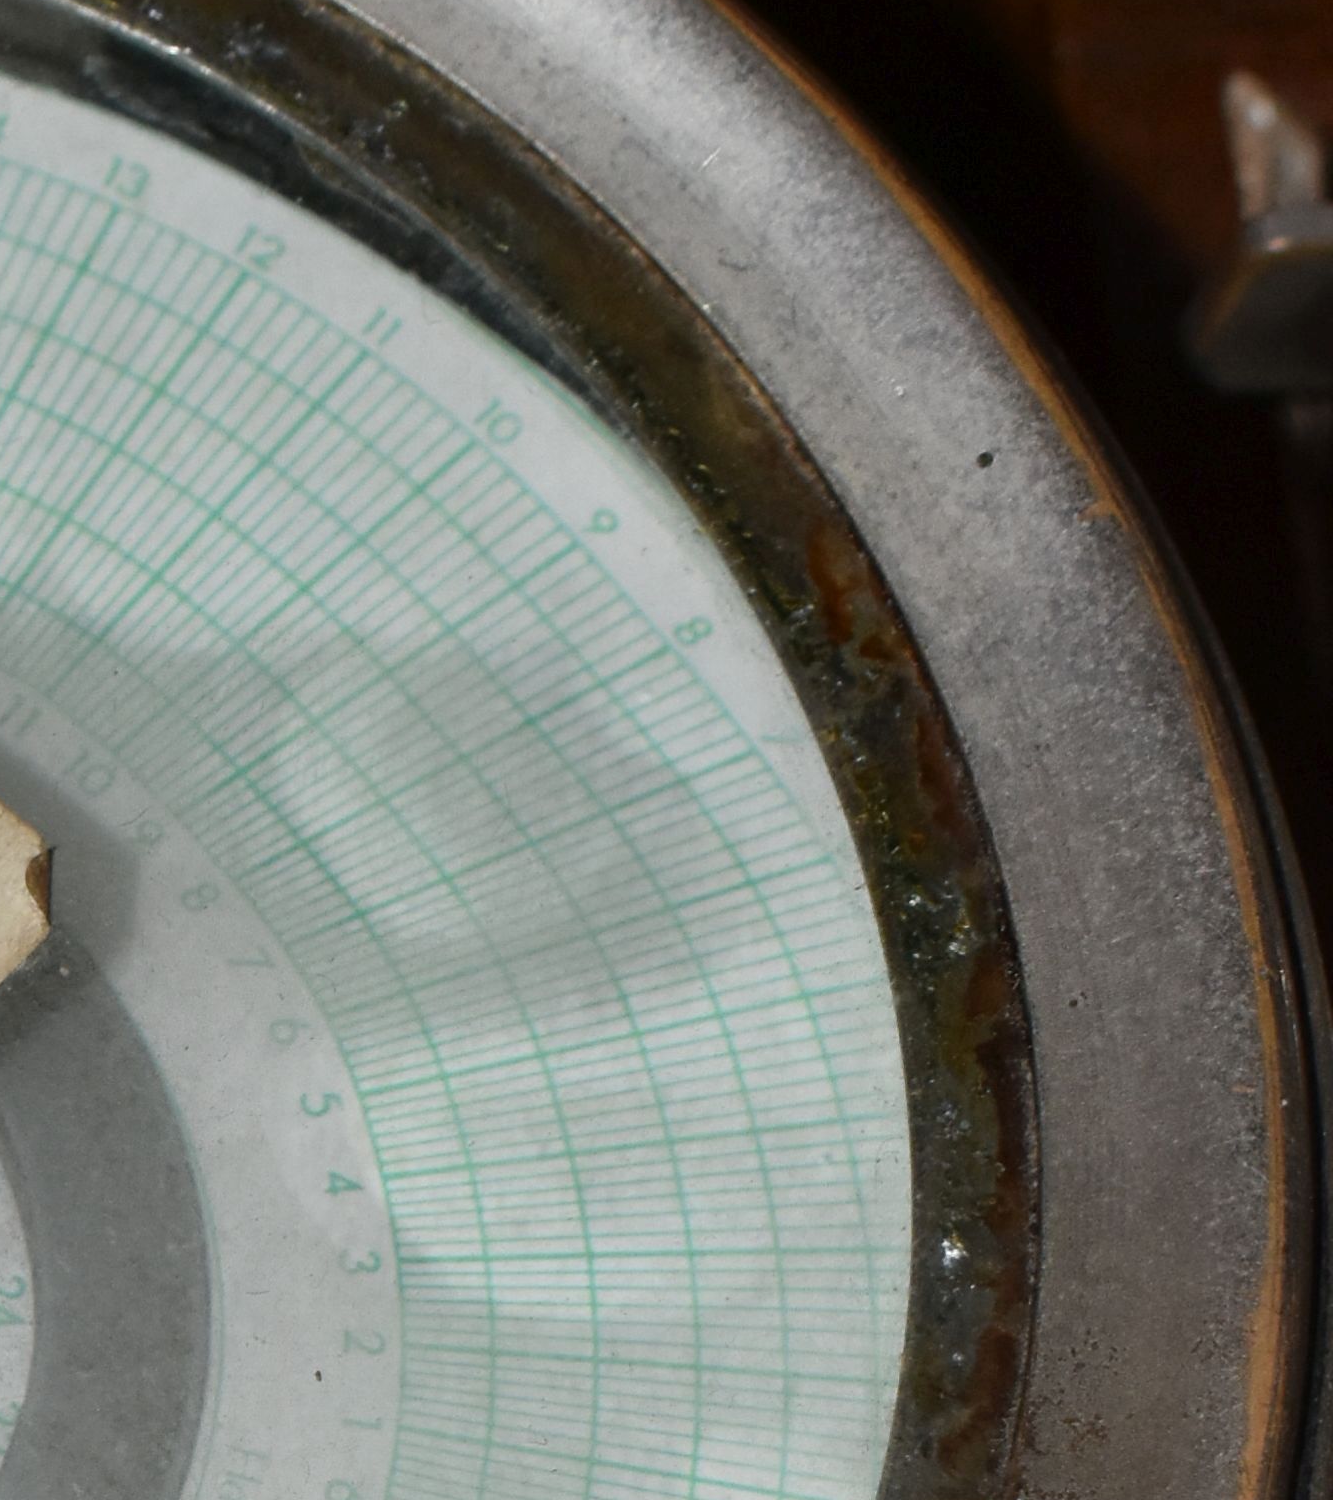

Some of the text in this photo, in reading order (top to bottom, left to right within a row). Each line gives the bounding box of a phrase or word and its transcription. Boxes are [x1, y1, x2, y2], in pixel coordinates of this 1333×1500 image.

[99, 154, 153, 199] 13
[235, 222, 287, 272] 12
[361, 306, 403, 347] 11
[473, 395, 524, 446] 10
[585, 506, 622, 537] 9
[672, 613, 714, 647] 8
[180, 880, 222, 913] 8
[226, 946, 277, 970] 7
[267, 1016, 311, 1047] 6
[299, 1091, 344, 1118] 5
[324, 1169, 364, 1197] 4
[337, 1249, 382, 1276] 3
[340, 1328, 387, 1356] 2
[339, 1415, 383, 1431] 1
